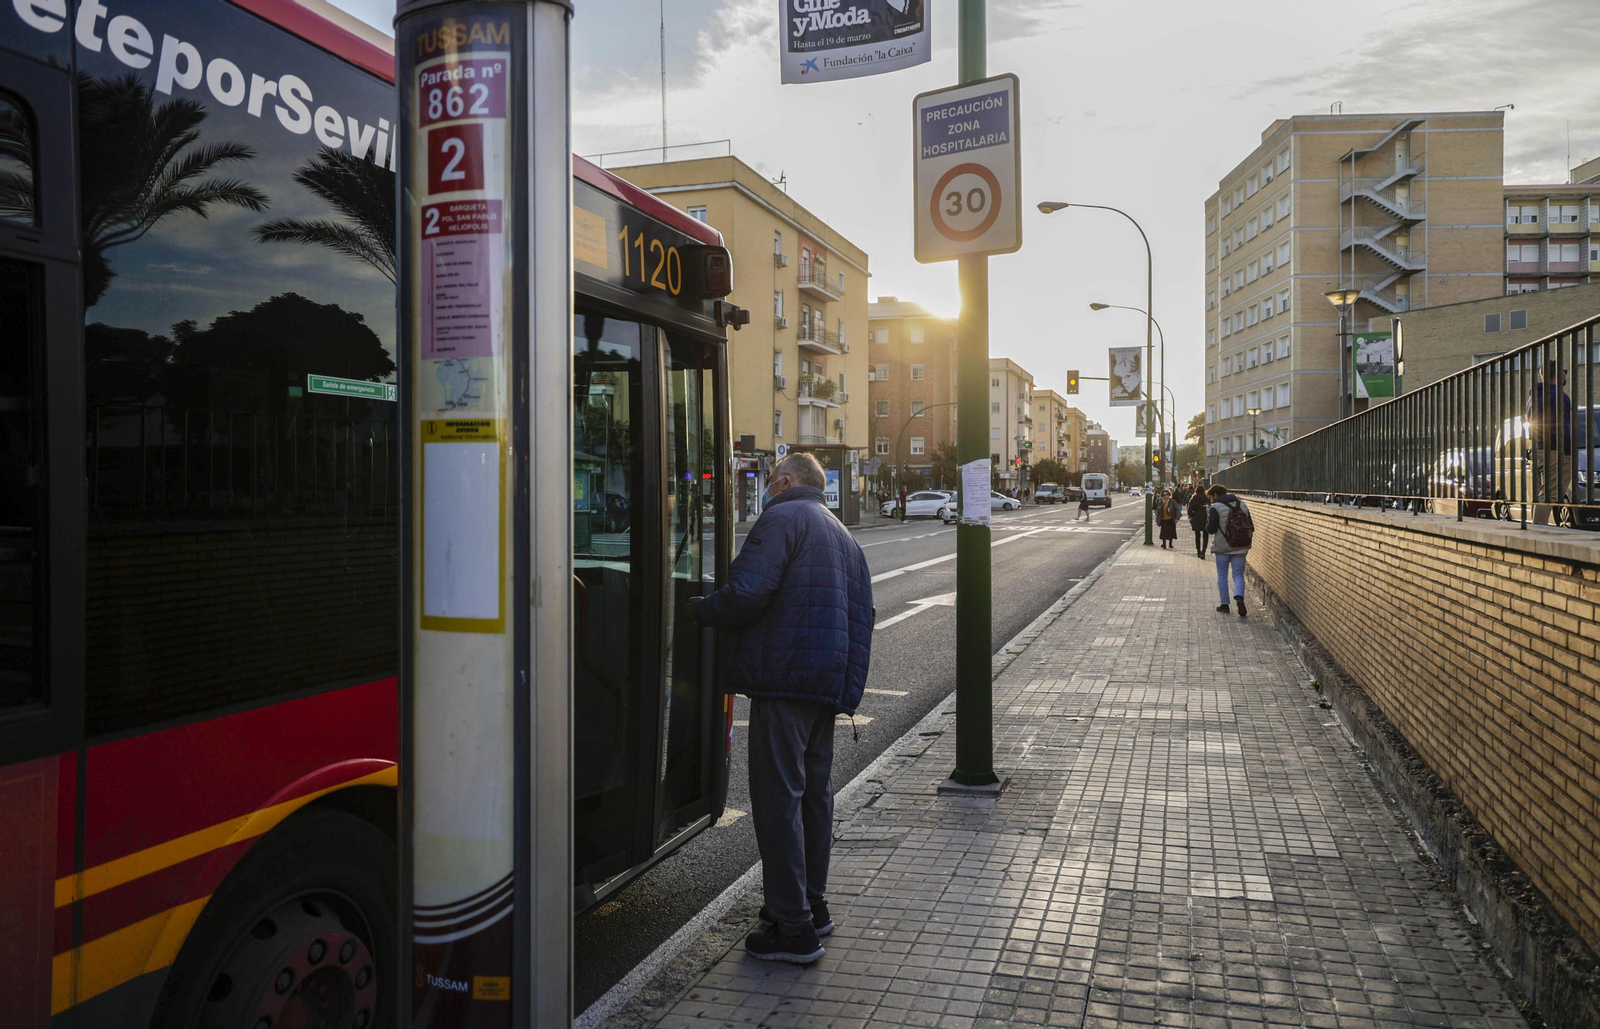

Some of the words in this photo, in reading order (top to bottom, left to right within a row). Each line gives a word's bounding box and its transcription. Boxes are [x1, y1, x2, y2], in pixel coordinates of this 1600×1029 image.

[417, 22, 510, 56] TUSSAM
[794, 40, 816, 49] Hasta
[817, 38, 824, 46] el
[826, 37, 834, 45] 19
[836, 36, 846, 44] de
[847, 33, 871, 43] marzo
[824, 53, 873, 67] Fundación
[421, 65, 475, 88] Parada
[428, 83, 489, 120] 862
[926, 96, 1003, 123] PRECAUCIÓN
[948, 119, 981, 135] ZONA
[923, 131, 1007, 157] HOSPITALARIA
[441, 137, 466, 182] 2
[449, 203, 487, 212] BARQUETA
[945, 187, 986, 217] 30
[425, 207, 440, 235] 2
[472, 212, 497, 220] PABLO
[619, 225, 682, 296] 1120
[323, 381, 338, 389] Salida
[347, 385, 374, 393] emergencia
[427, 974, 468, 992] TUSSAM
